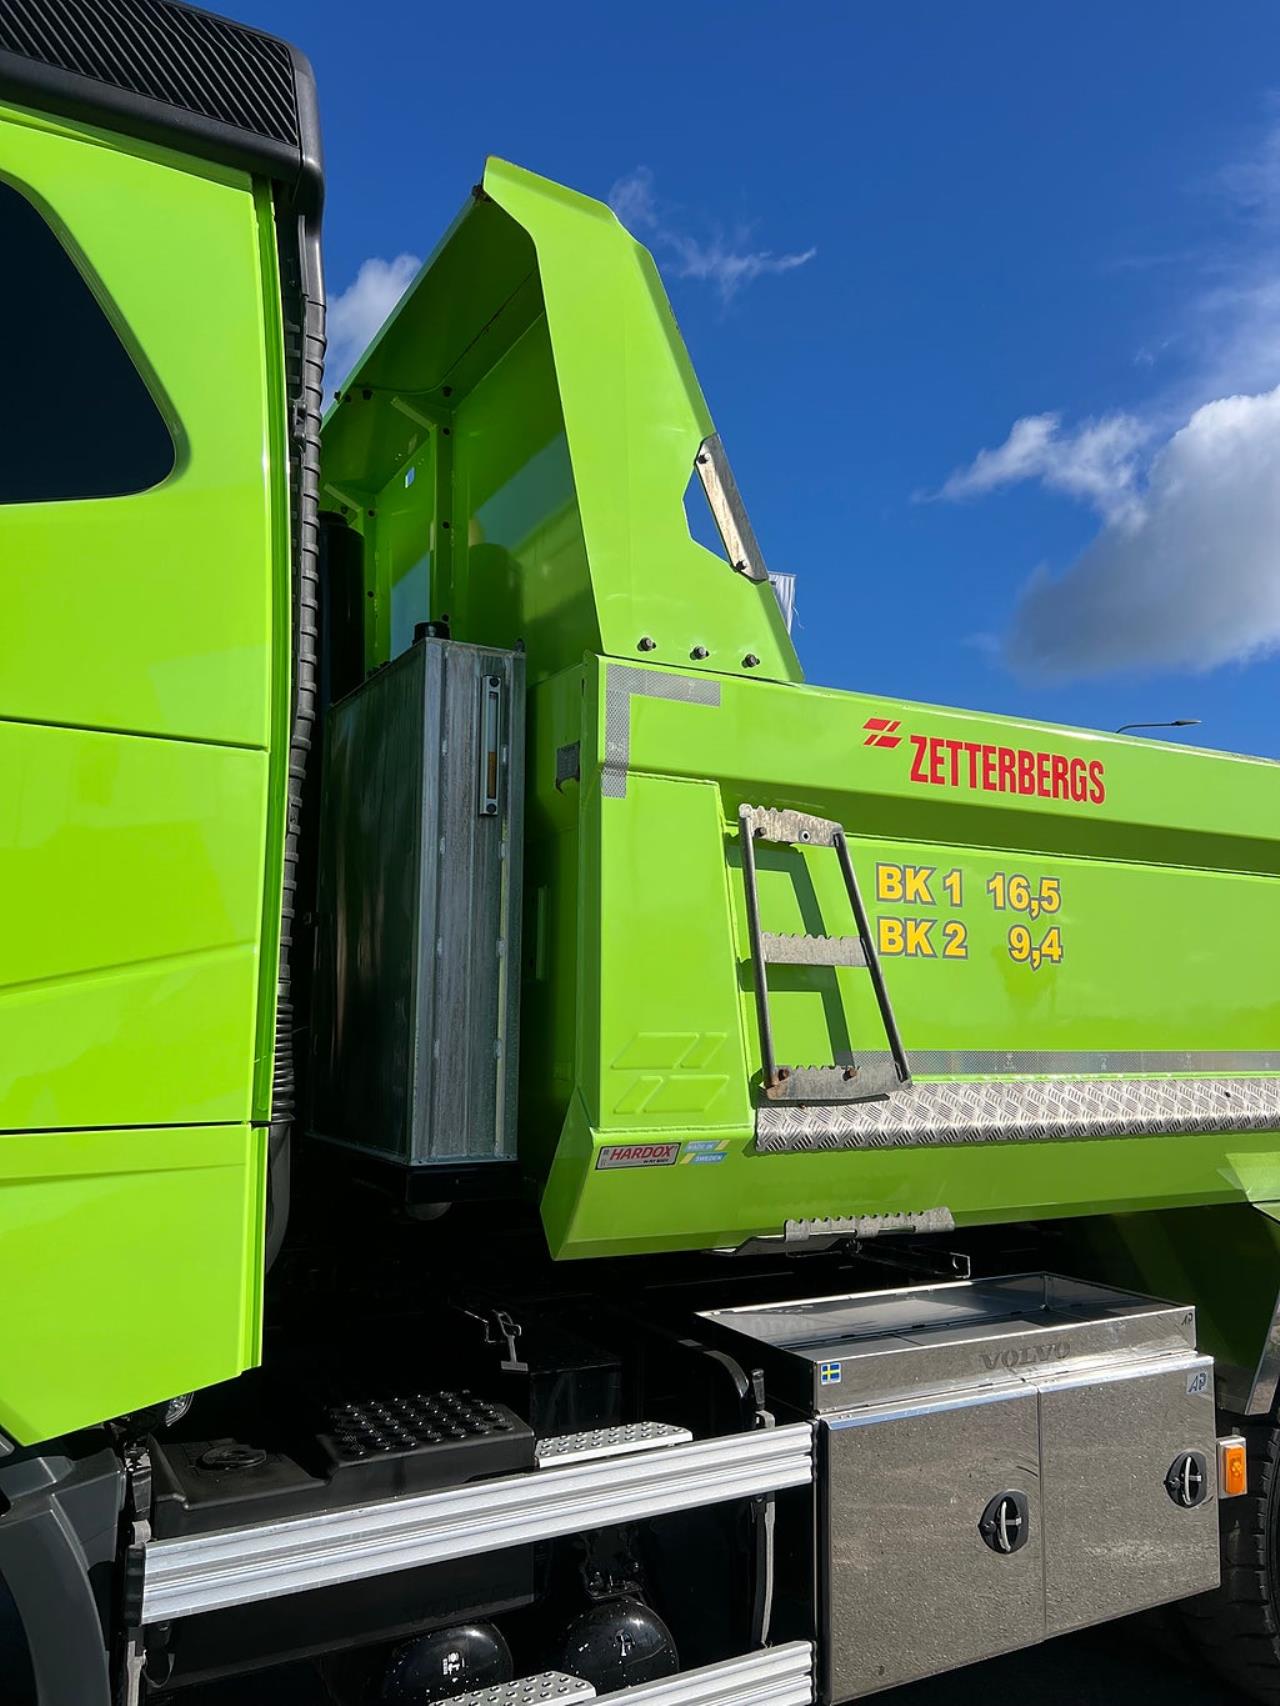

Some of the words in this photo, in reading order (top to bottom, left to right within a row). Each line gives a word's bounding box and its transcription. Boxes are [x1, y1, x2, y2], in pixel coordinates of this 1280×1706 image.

[910, 734, 1105, 804] ZETTERBERGS
[876, 862, 936, 905] BK
[943, 869, 963, 906] 1
[987, 872, 1061, 920] 16,5
[877, 916, 937, 958] BK
[943, 920, 968, 958] 2
[1008, 925, 1063, 971] 9,4
[609, 1145, 674, 1161] HARDOX
[694, 1153, 723, 1162] SWEDEN
[979, 1342, 1071, 1370] VOLVO
